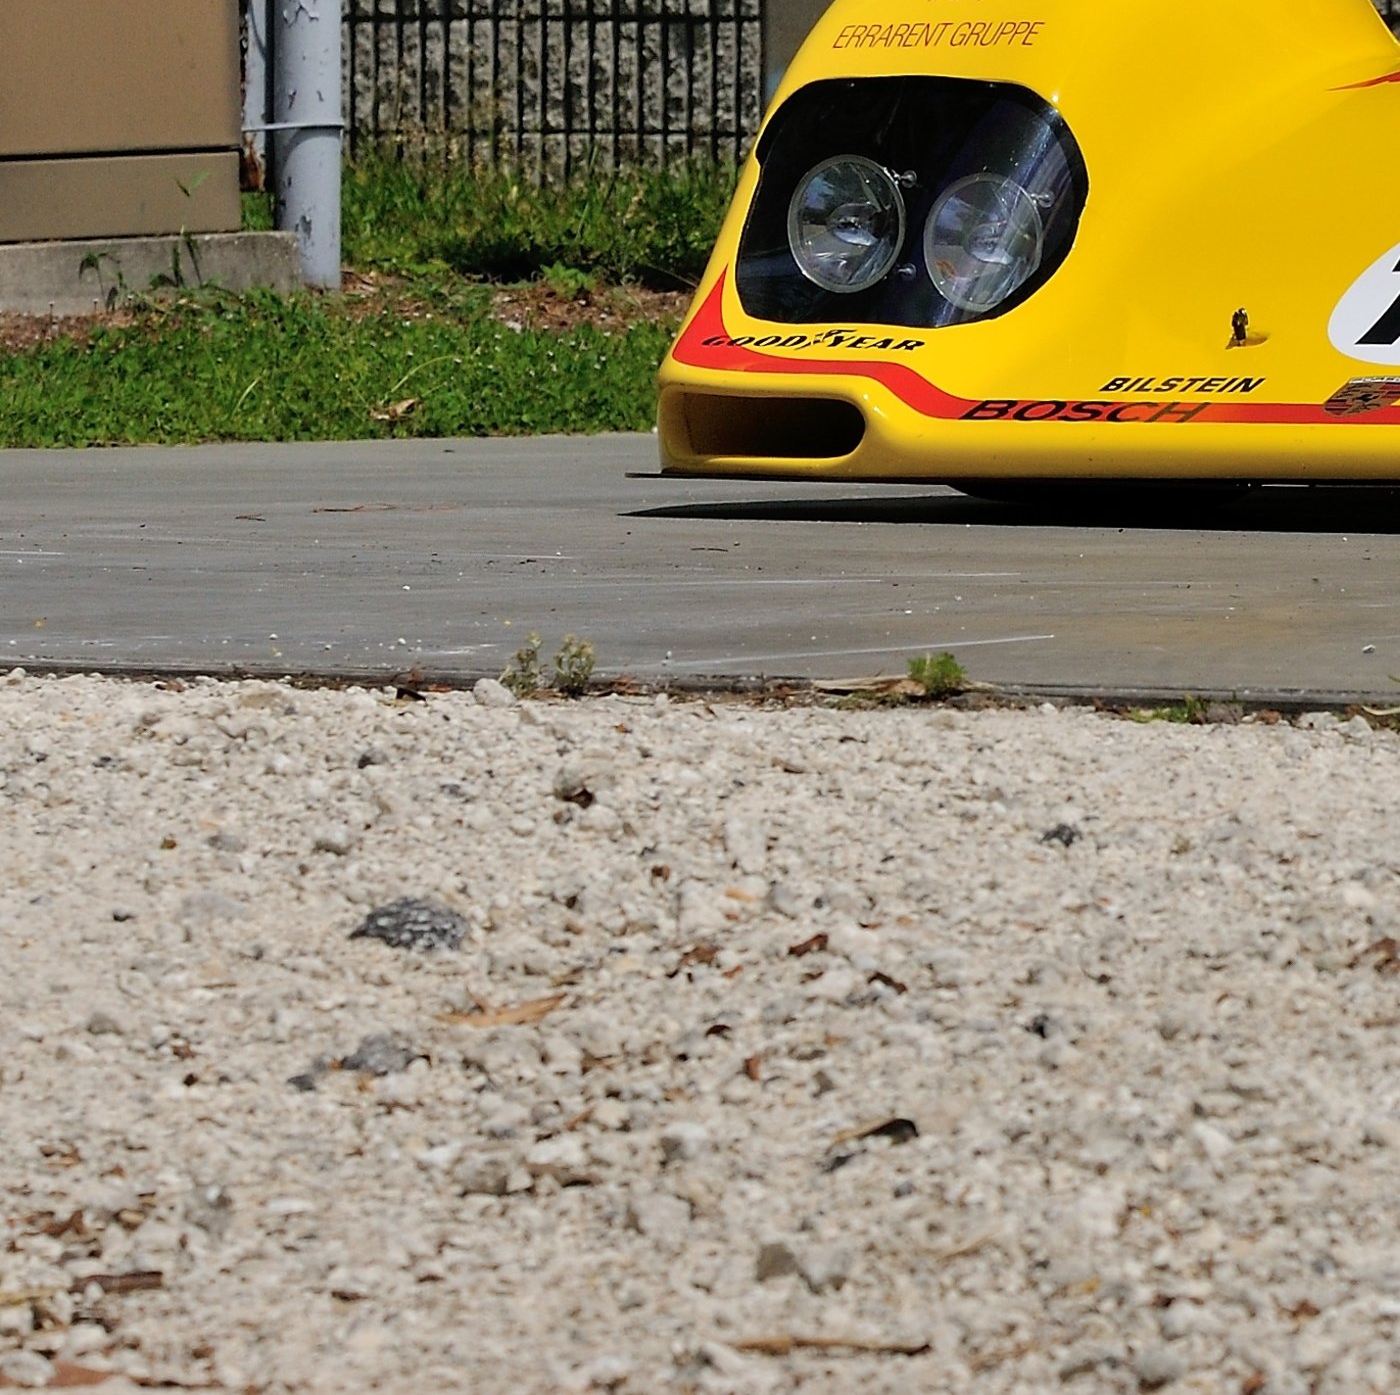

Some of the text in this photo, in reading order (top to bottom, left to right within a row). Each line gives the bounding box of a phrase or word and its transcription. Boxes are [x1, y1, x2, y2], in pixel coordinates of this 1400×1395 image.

[949, 21, 1046, 47] GRUPPE
[700, 328, 926, 352] GOODYEAR
[1099, 376, 1266, 393] BILSTEIN
[958, 399, 1212, 423] BOSCH
